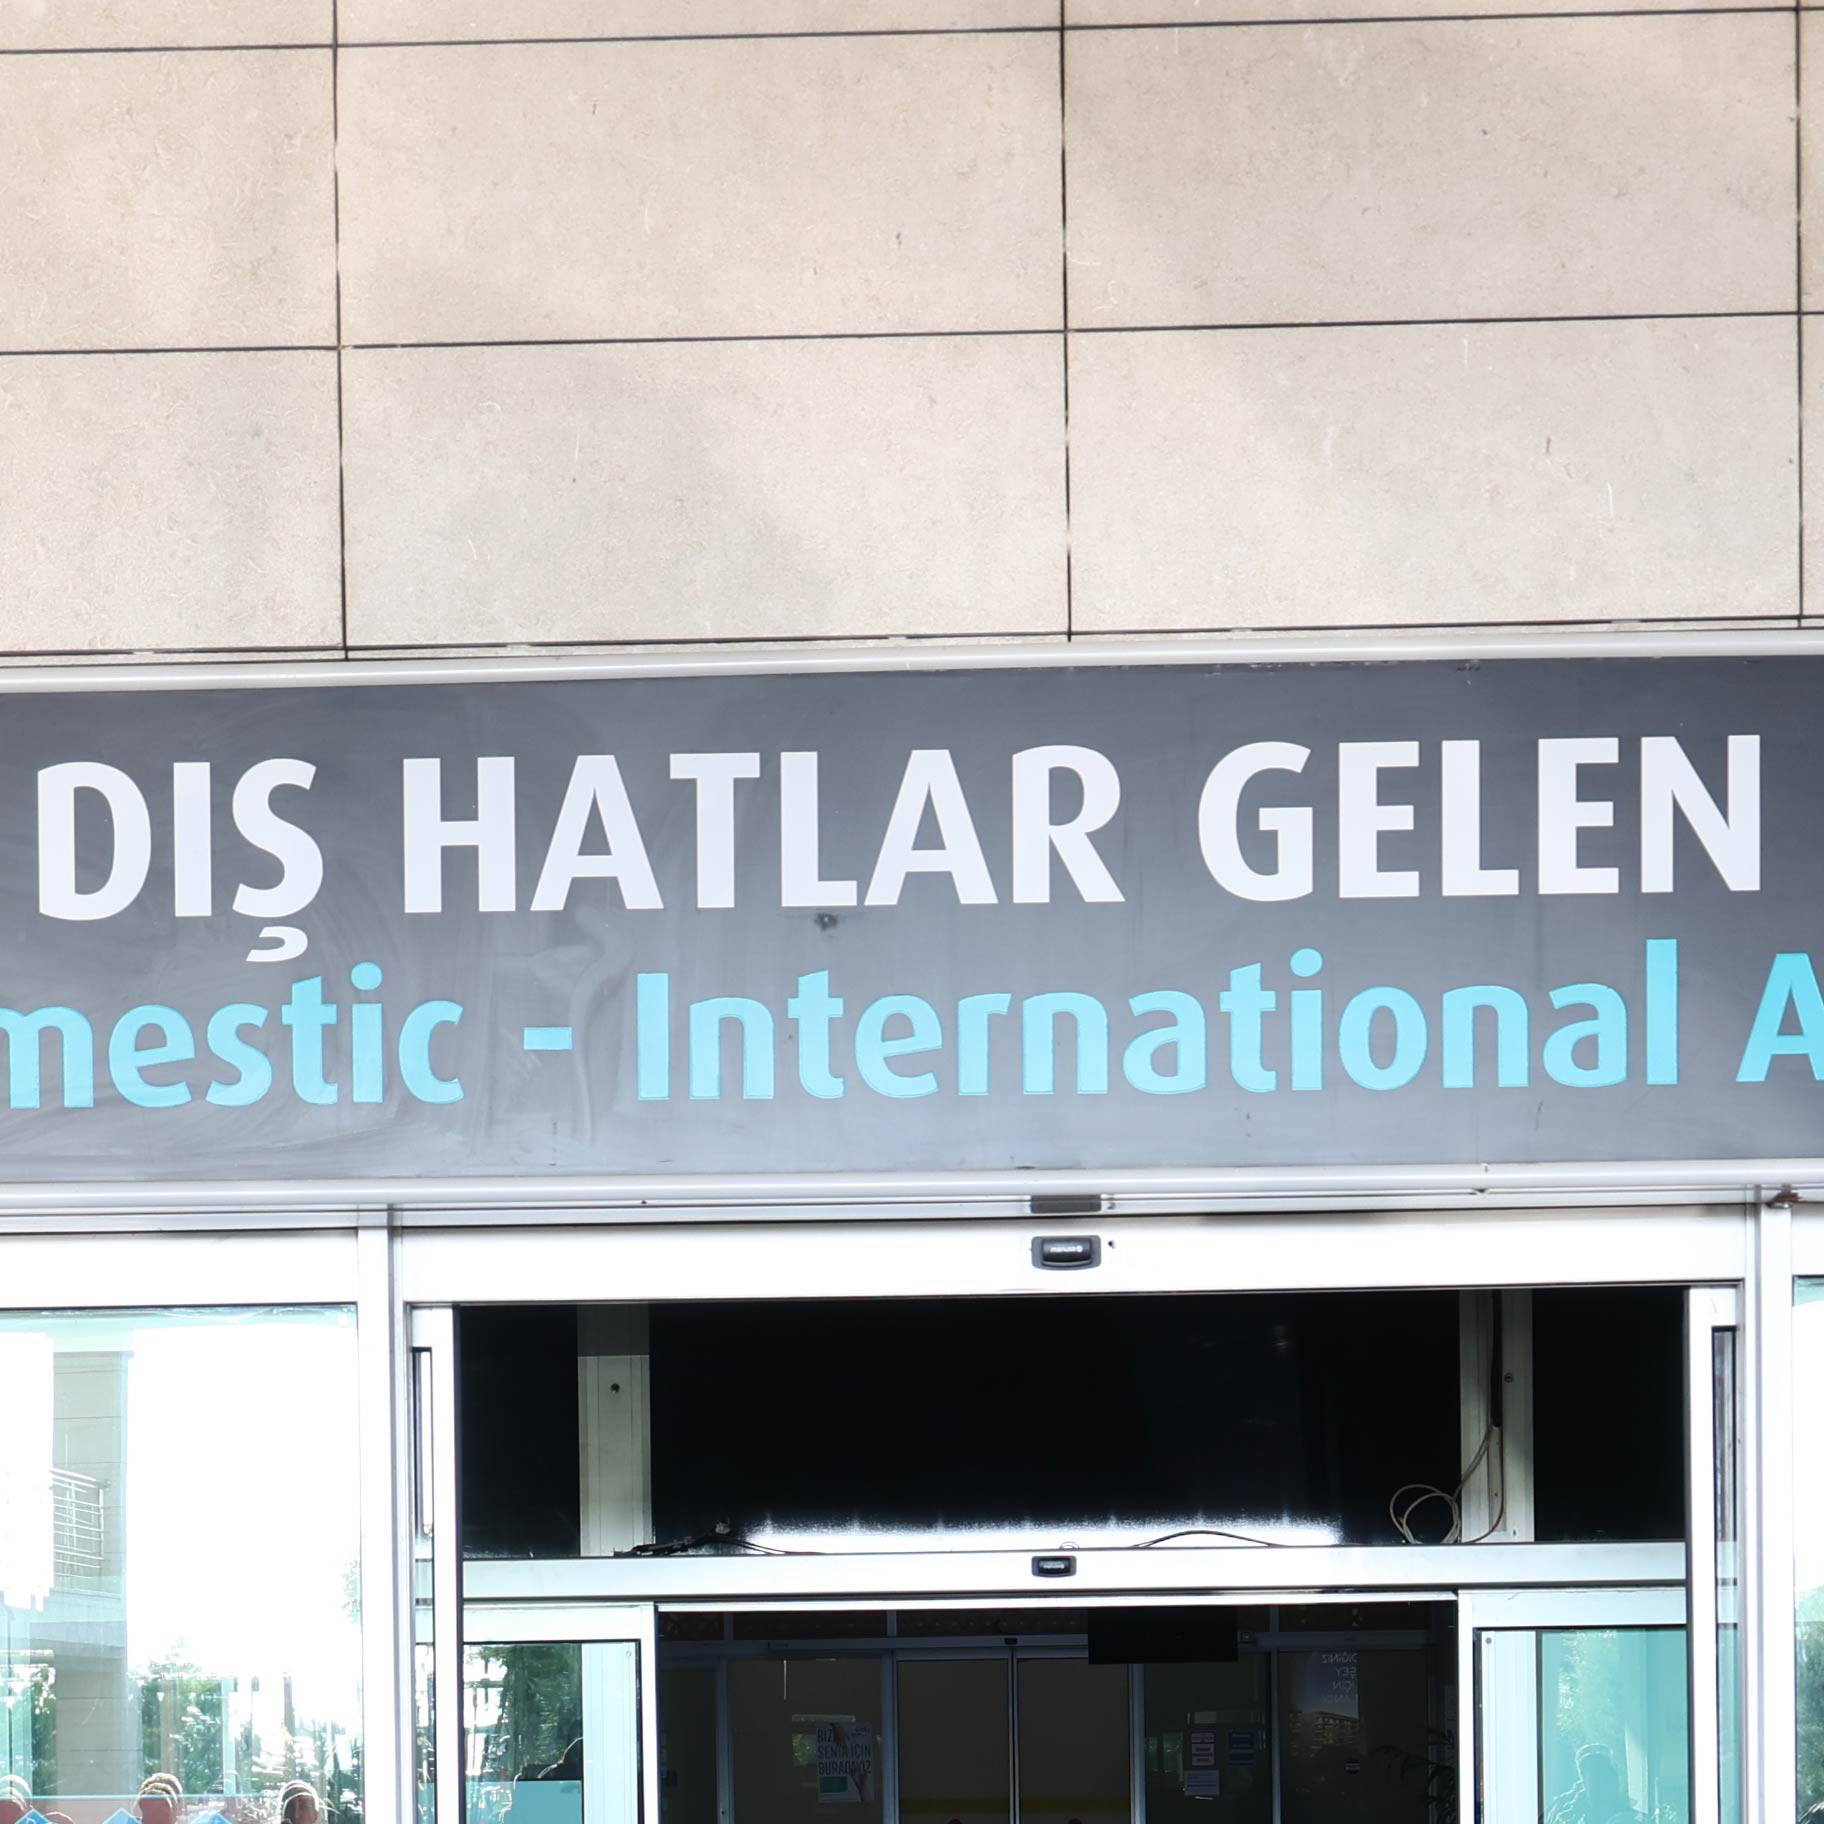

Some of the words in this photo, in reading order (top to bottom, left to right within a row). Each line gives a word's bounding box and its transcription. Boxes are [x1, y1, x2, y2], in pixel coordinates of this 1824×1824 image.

[38, 757, 323, 964] DIŞ
[404, 745, 1125, 913] HATLAR
[1198, 735, 1760, 901] GELEN
[523, 1027, 574, 1050] -
[637, 938, 1680, 1100] International
